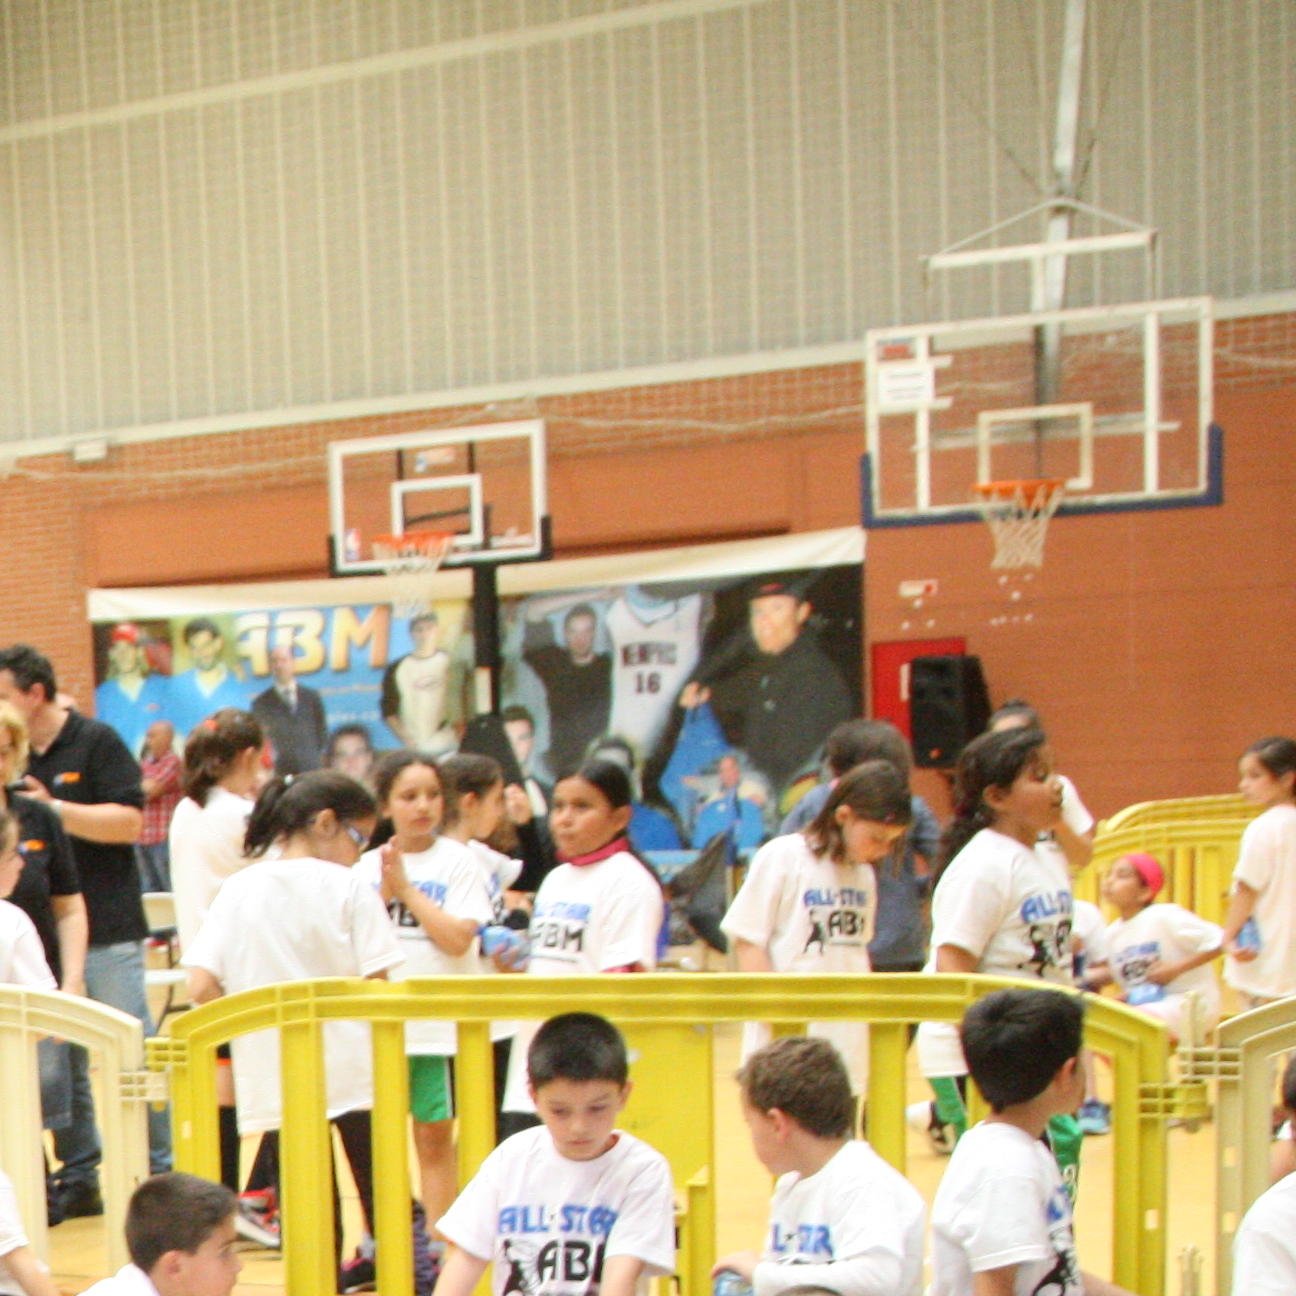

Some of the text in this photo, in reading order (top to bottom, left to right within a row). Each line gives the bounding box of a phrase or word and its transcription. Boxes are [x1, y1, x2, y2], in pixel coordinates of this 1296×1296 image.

[234, 604, 392, 681] ABM
[635, 672, 662, 694] 16
[498, 1206, 550, 1234] ALL
